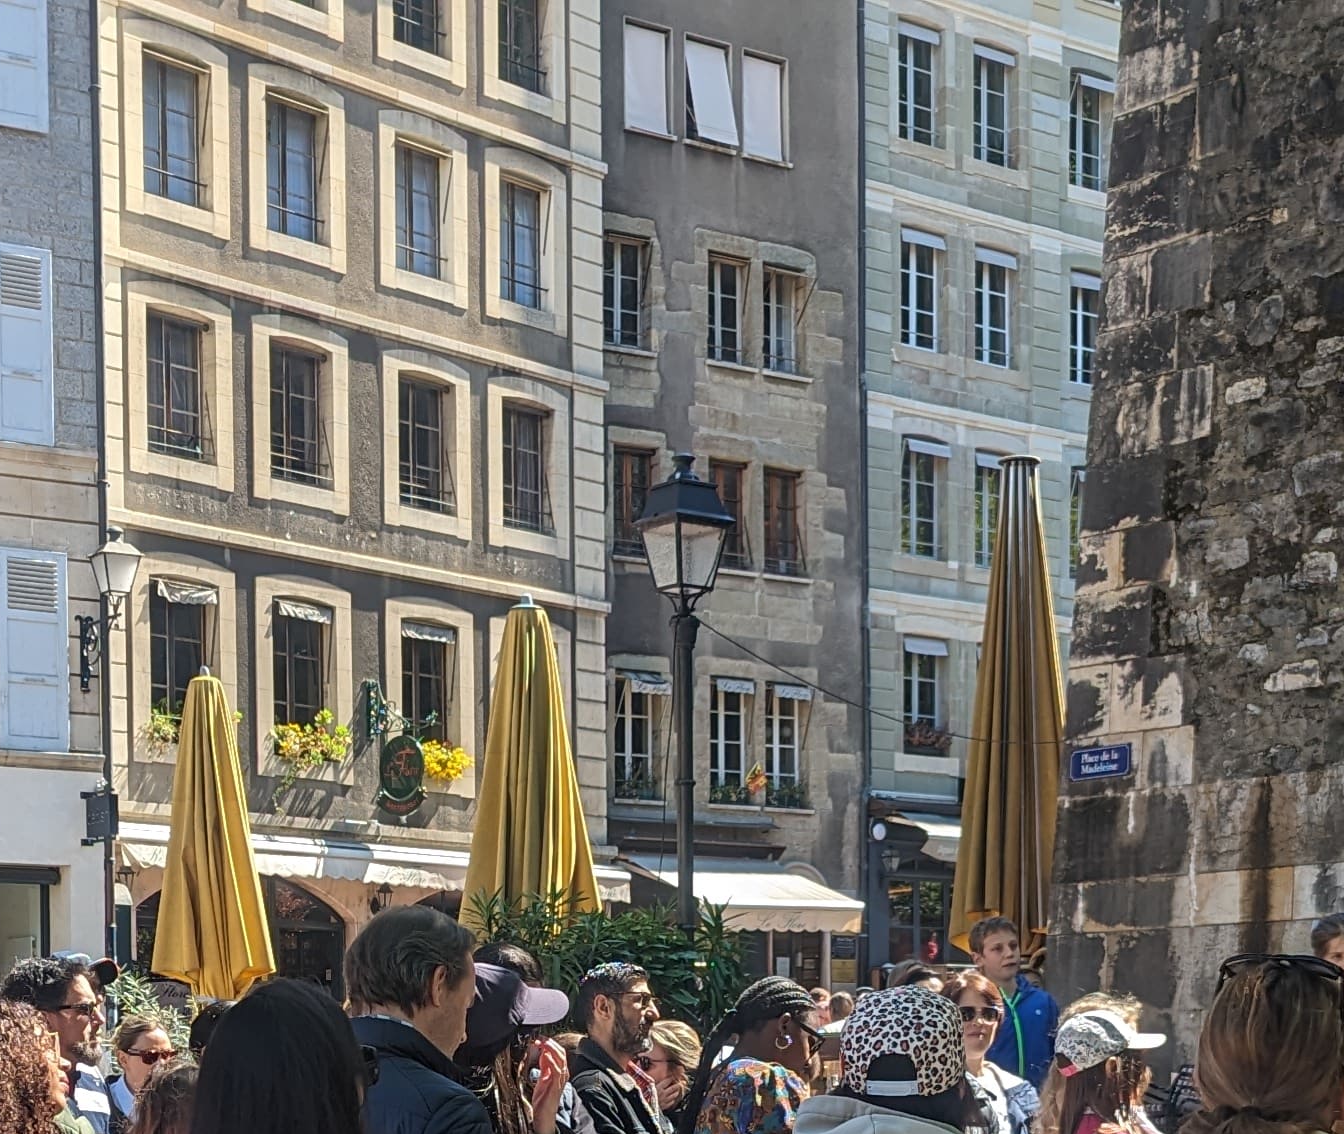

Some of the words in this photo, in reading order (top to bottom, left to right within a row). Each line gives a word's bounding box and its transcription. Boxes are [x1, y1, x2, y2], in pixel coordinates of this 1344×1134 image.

[1081, 753, 1099, 763] Place
[1100, 751, 1110, 761] de
[1111, 750, 1119, 760] la
[1081, 762, 1119, 775] Madeleine
